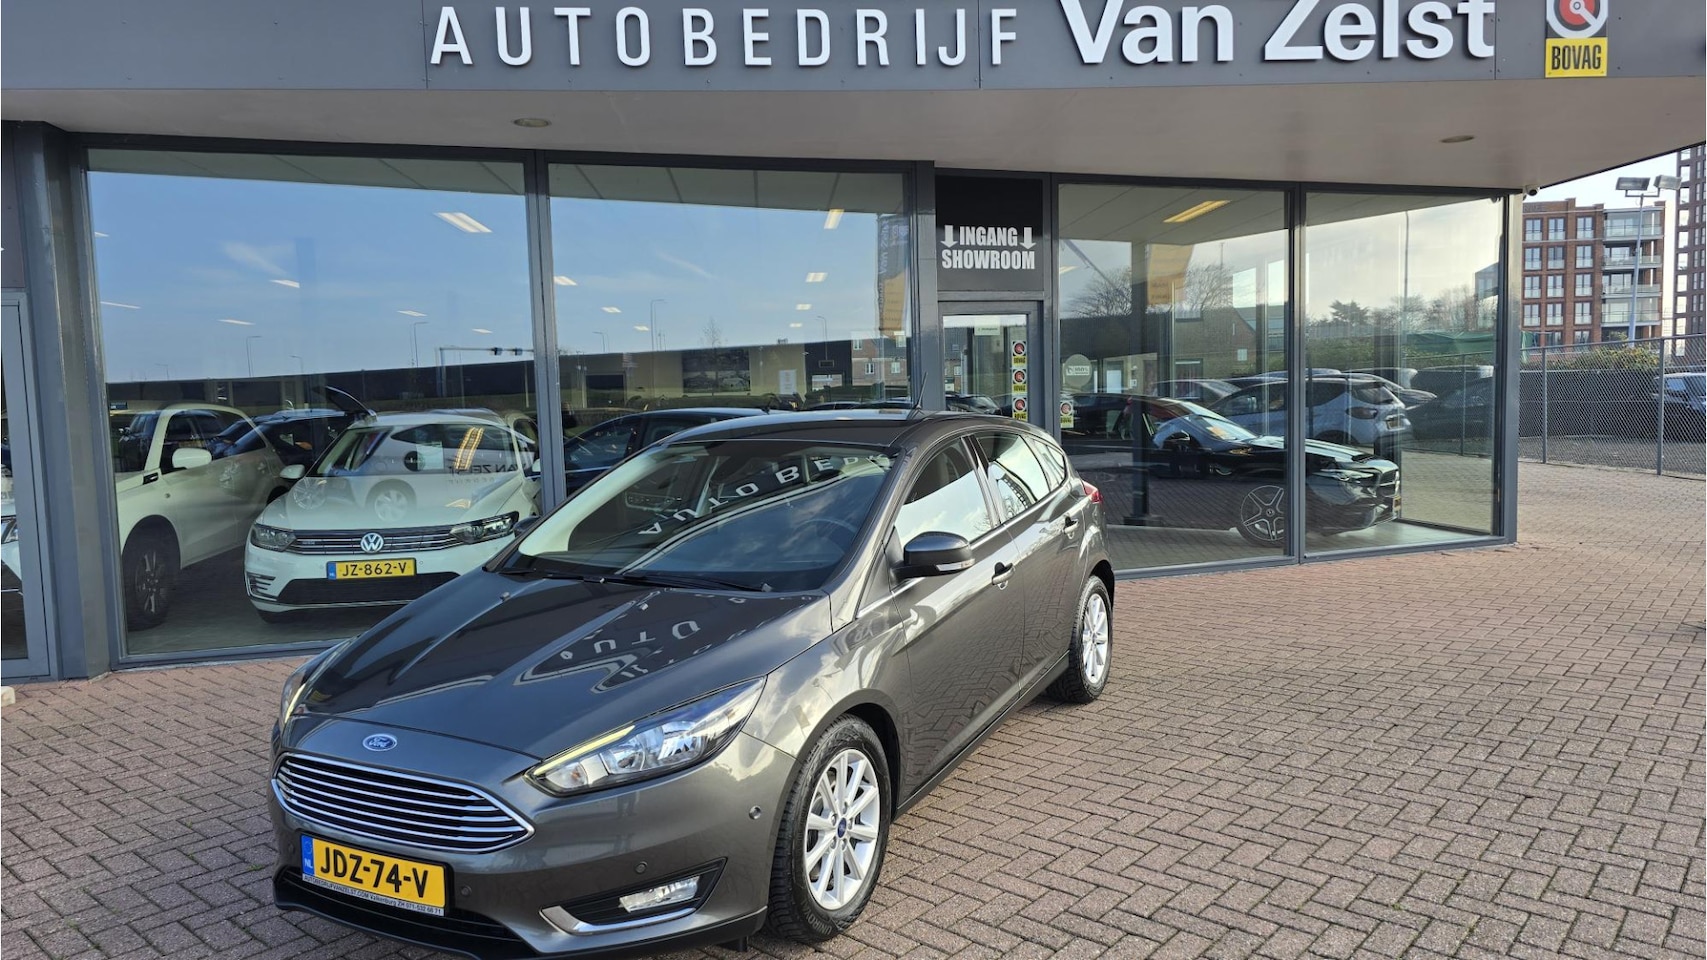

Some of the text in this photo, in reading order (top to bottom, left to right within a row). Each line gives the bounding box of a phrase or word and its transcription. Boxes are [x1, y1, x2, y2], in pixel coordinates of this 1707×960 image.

[430, 7, 1017, 67] AUTOBEDRIJF
[1062, 0, 1495, 64] Van Zelst
[1551, 45, 1602, 70] BOVAG
[959, 226, 1018, 247] INGANG
[941, 249, 1036, 270] SHOWROOM
[342, 562, 407, 577] JZ-862-V
[304, 857, 314, 869] NL
[320, 846, 429, 898] JDZ-74-V
[800, 899, 833, 936] UNIROY
